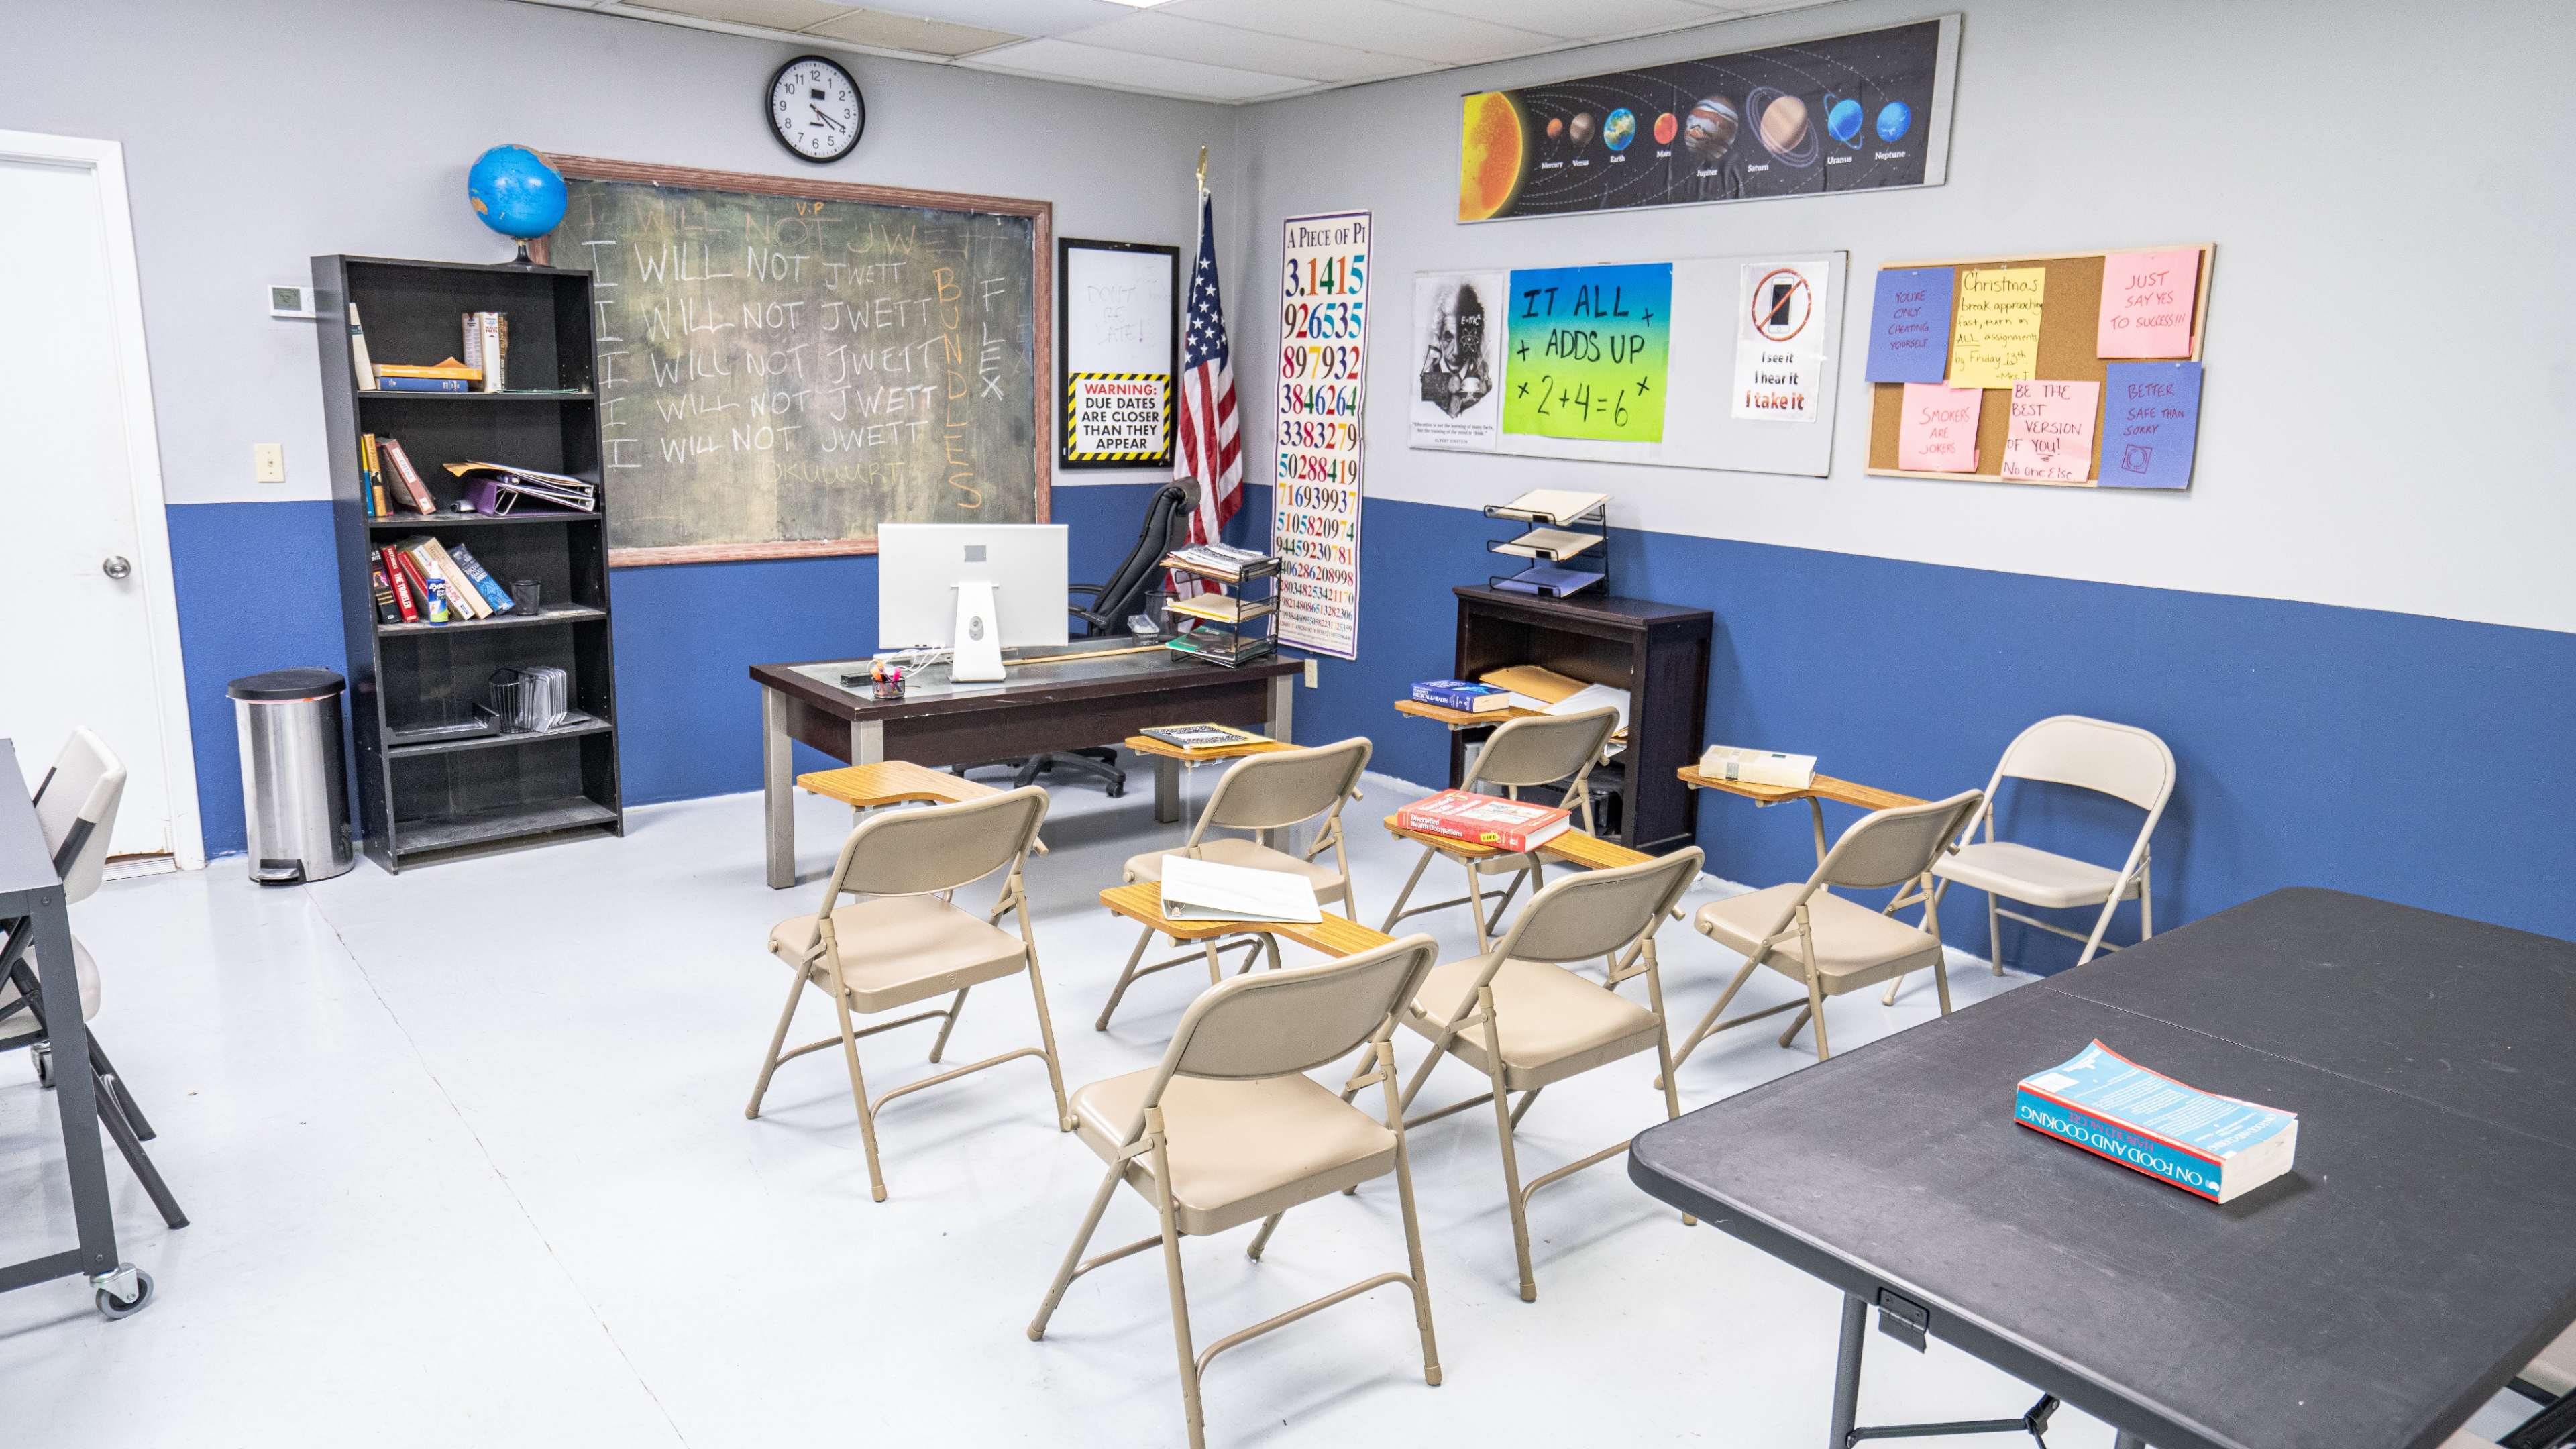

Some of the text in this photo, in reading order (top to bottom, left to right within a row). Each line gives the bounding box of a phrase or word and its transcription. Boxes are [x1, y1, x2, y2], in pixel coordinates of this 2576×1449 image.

[794, 74, 804, 85] 11
[810, 70, 820, 82] 12
[784, 83, 795, 95] 10
[827, 78, 832, 89] 1
[839, 90, 845, 101] 2
[780, 100, 786, 111] 9
[843, 108, 850, 119] 3
[784, 118, 792, 129] 8
[839, 125, 846, 136] 4
[797, 132, 804, 142] 7
[812, 138, 819, 149] 6
[827, 136, 834, 146] 5
[1610, 154, 1625, 163] Earth
[1656, 150, 1672, 158] Mars
[1827, 155, 1852, 165] Uranus
[1875, 150, 1906, 161] Neptune
[1542, 160, 1564, 169] Mercury
[1572, 159, 1589, 168] Venus
[1748, 163, 1770, 172] Saturn
[1697, 168, 1718, 178] Jupiter
[745, 211, 842, 252] NOT
[1287, 228, 1295, 248] A
[581, 241, 618, 286] I
[635, 242, 733, 284] WILL
[747, 246, 810, 282] NOT
[1285, 254, 1365, 297] 3.1415
[1964, 271, 2039, 292] Christmas
[2125, 271, 2169, 290] JUST
[1522, 284, 1629, 319] IT ALL
[1961, 297, 1990, 312] break
[2125, 290, 2174, 309] SAY YES
[594, 297, 932, 342] I WILL NOT JWETT
[1894, 306, 1921, 319] ONLY
[1284, 302, 1363, 339] 926535
[1984, 318, 2012, 326] turn
[2110, 316, 2130, 331] TO
[1888, 321, 1929, 335] CHEATING
[979, 276, 1006, 401] FLEX
[1890, 338, 1929, 351] YOURSELF
[1956, 333, 2038, 347] ALL assignments
[1546, 328, 1645, 364] ADDS UP
[597, 335, 946, 388] I WILL NOT JWETT
[1283, 345, 1360, 380] 897932
[1762, 351, 1794, 364] I see it
[1955, 351, 1965, 371] by
[1970, 350, 2001, 370] Friday
[1755, 370, 1799, 385] I hear it
[932, 268, 982, 508] BUNDLES
[1085, 384, 1157, 396] WARNING:
[2015, 384, 2070, 400] BE THE
[2127, 382, 2175, 400] BETTER
[600, 384, 937, 427] I WILL NOT JWETT
[1085, 398, 1155, 409] DUE DATES
[1281, 384, 1357, 417] 3846264
[1746, 390, 1804, 411] I take it
[2012, 402, 2047, 417] BEST
[2127, 407, 2184, 421] SAFE THAN
[1081, 411, 1159, 423] ARE CLOSER
[1083, 425, 1157, 436] THAN THEY
[1929, 427, 1949, 439] ARE
[2025, 420, 2082, 435] VERSION
[2123, 424, 2159, 437] SORRY
[1280, 420, 1357, 451] 3383279
[602, 421, 929, 468] I WILL NOT JWETT
[1096, 438, 1147, 449] APPEAR
[1919, 442, 1956, 455] JOKERS
[2007, 437, 2061, 456] OF YOU!
[1279, 453, 1357, 485] 50288419
[2004, 461, 2020, 475] No
[2024, 466, 2044, 476] one
[1278, 483, 1356, 515] 716939937
[1277, 512, 1354, 542] 5105820974
[1276, 536, 1352, 566] 94459230781
[1411, 814, 1440, 825] Diversified
[1411, 821, 1463, 837] Health Occupations
[2021, 1106, 2203, 1187] ON FOOD AND COOKING
